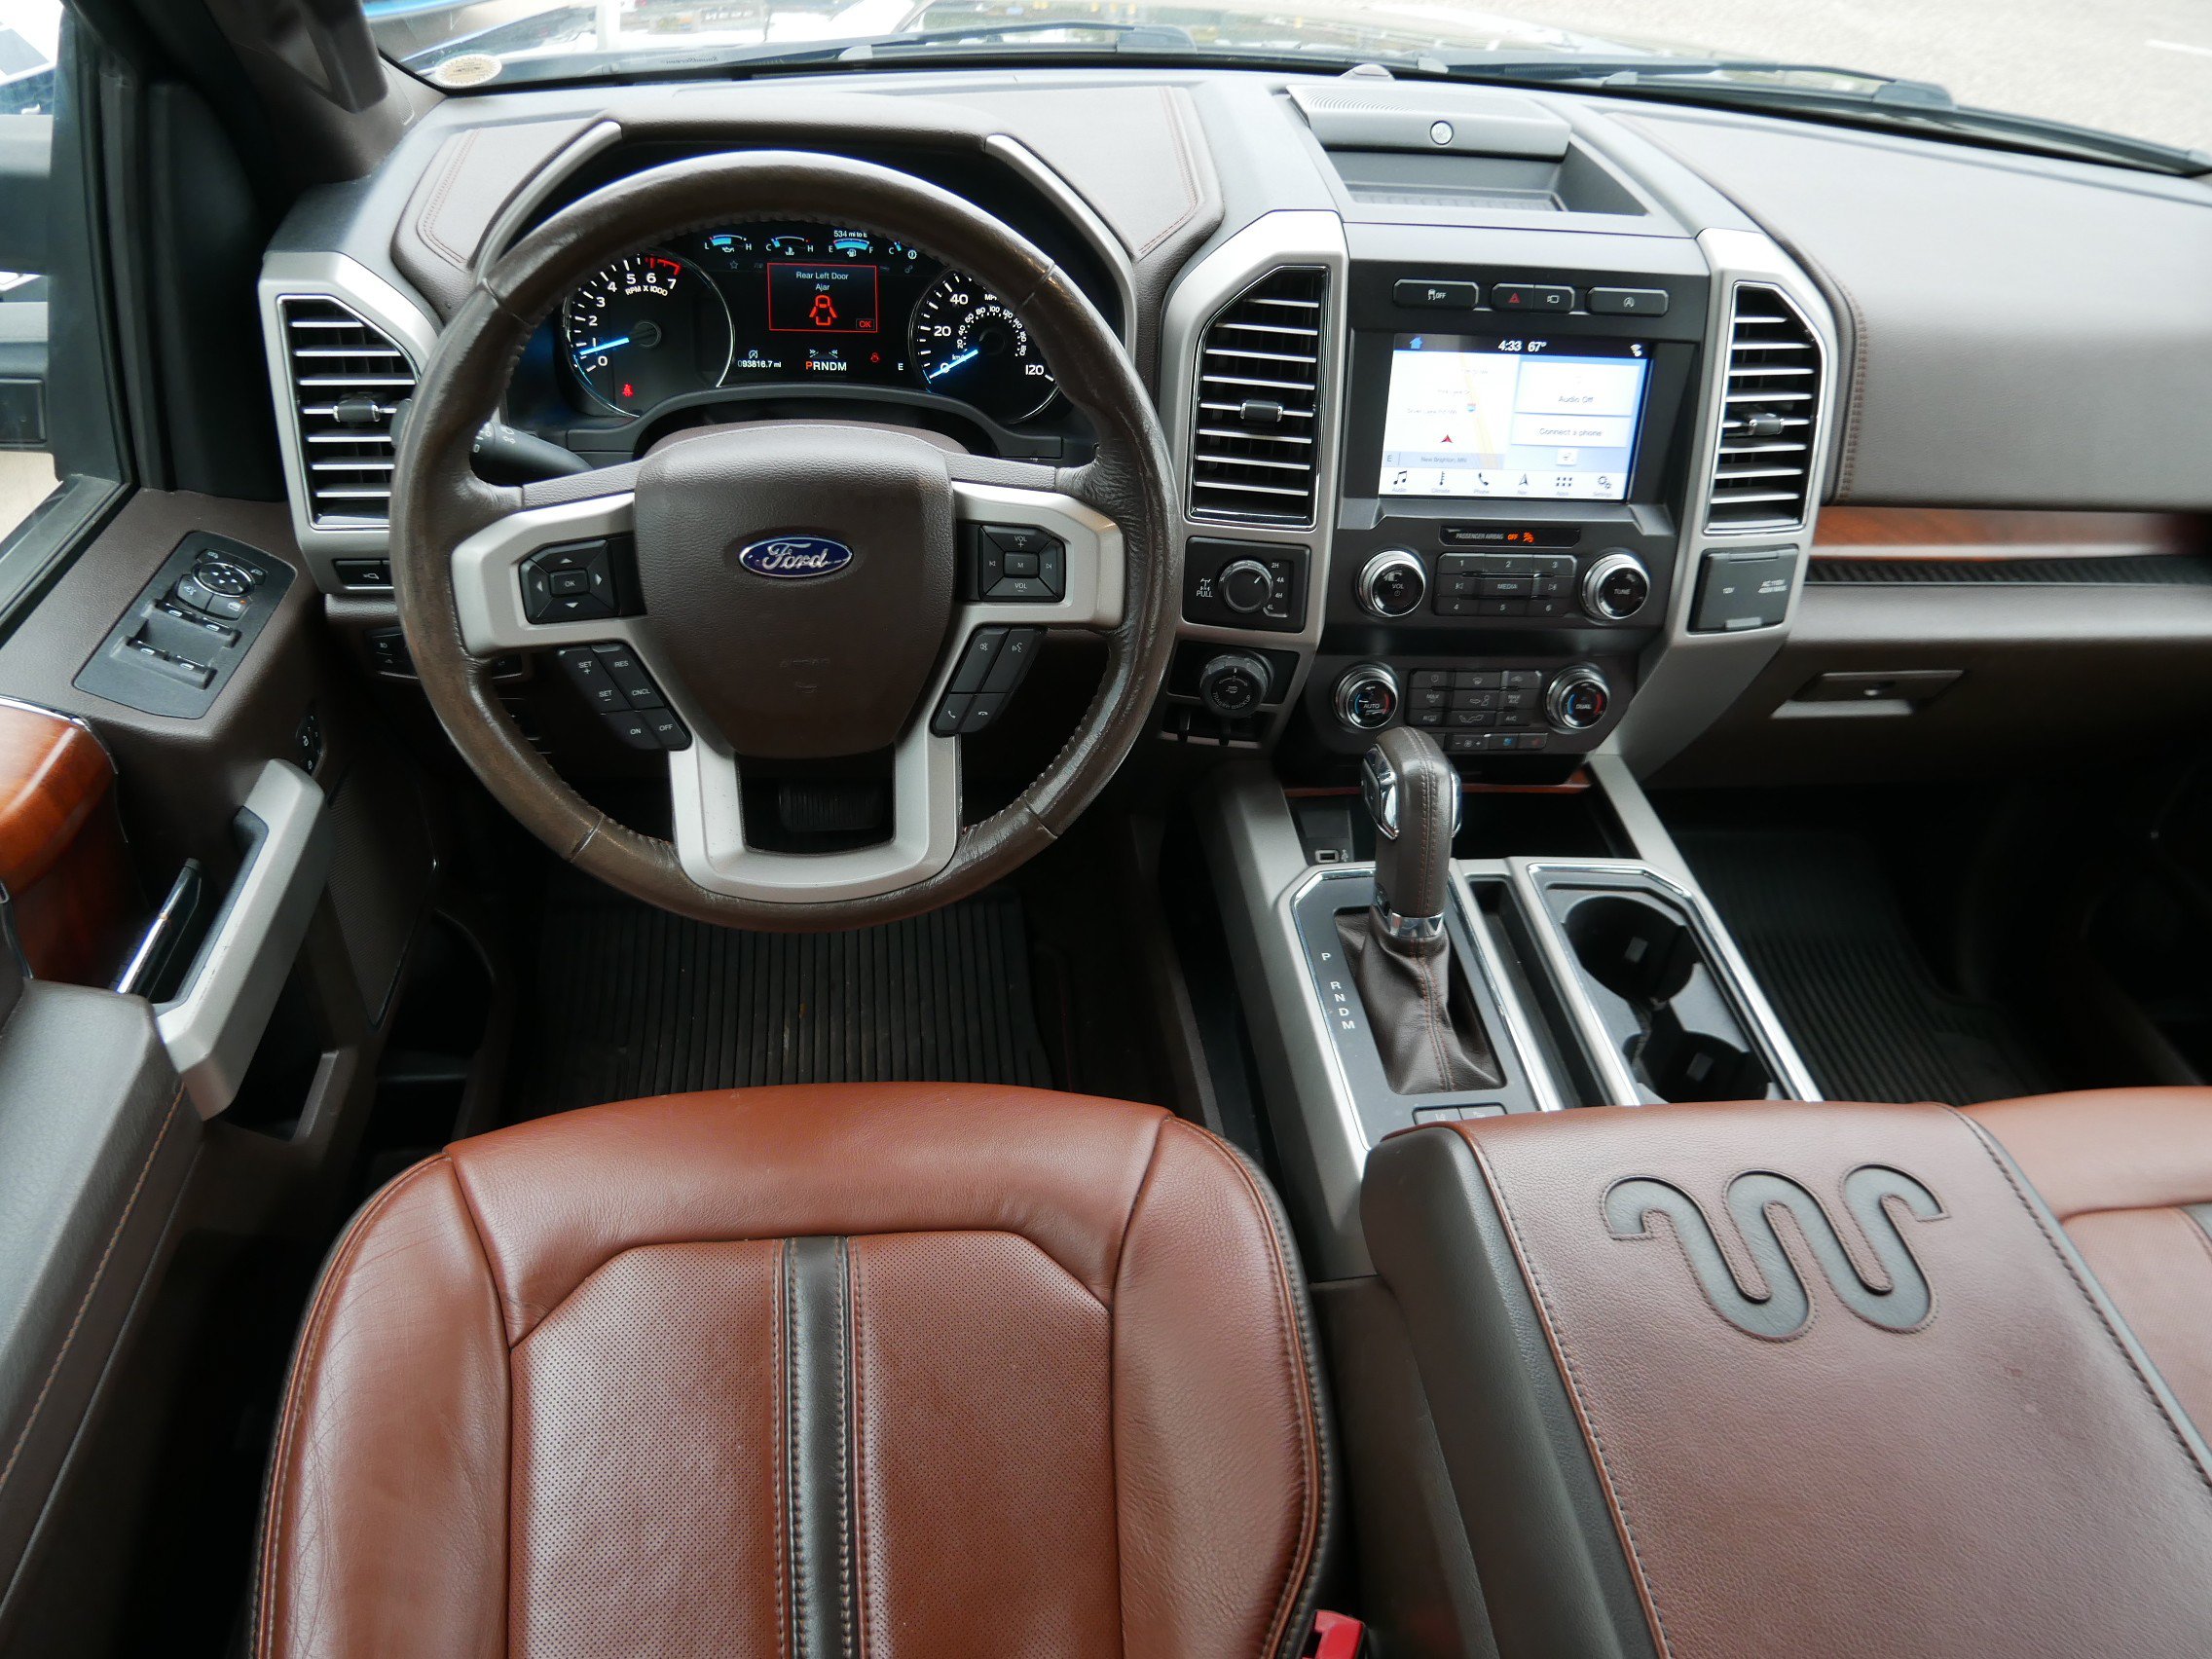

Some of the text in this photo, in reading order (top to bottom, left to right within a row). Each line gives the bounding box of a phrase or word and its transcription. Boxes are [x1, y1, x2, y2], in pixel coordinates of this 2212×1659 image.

[705, 241, 710, 250] L
[626, 274, 637, 284] 5
[646, 273, 656, 283] 6
[795, 271, 849, 280] Rear Left Door
[608, 281, 617, 293] 4
[667, 278, 677, 289] 7
[815, 283, 830, 292] Ajar
[625, 285, 642, 296] RPM
[649, 285, 669, 297] 1000
[1435, 291, 1447, 300] OFF
[596, 296, 606, 308] 3
[949, 293, 969, 305] 40
[976, 307, 986, 315] 80
[1002, 309, 1014, 319] 120
[588, 315, 598, 326] 2
[965, 313, 974, 323] 60
[934, 325, 951, 337] 20
[958, 325, 966, 336] 40
[957, 339, 964, 350] 20
[1497, 341, 1547, 352] 4:33 67°
[598, 355, 608, 366] 0
[737, 360, 773, 369] 093816.7
[805, 361, 847, 371] PRNDM
[940, 362, 950, 373] 0
[1025, 364, 1045, 376] 120
[762, 542, 831, 570] Ford
[577, 660, 593, 669] SET
[599, 689, 613, 698] SET
[1321, 952, 1332, 961] P
[1330, 980, 1342, 990] R
[1334, 993, 1346, 1002] N
[1338, 1007, 1350, 1016] D
[1342, 1020, 1355, 1030] M
